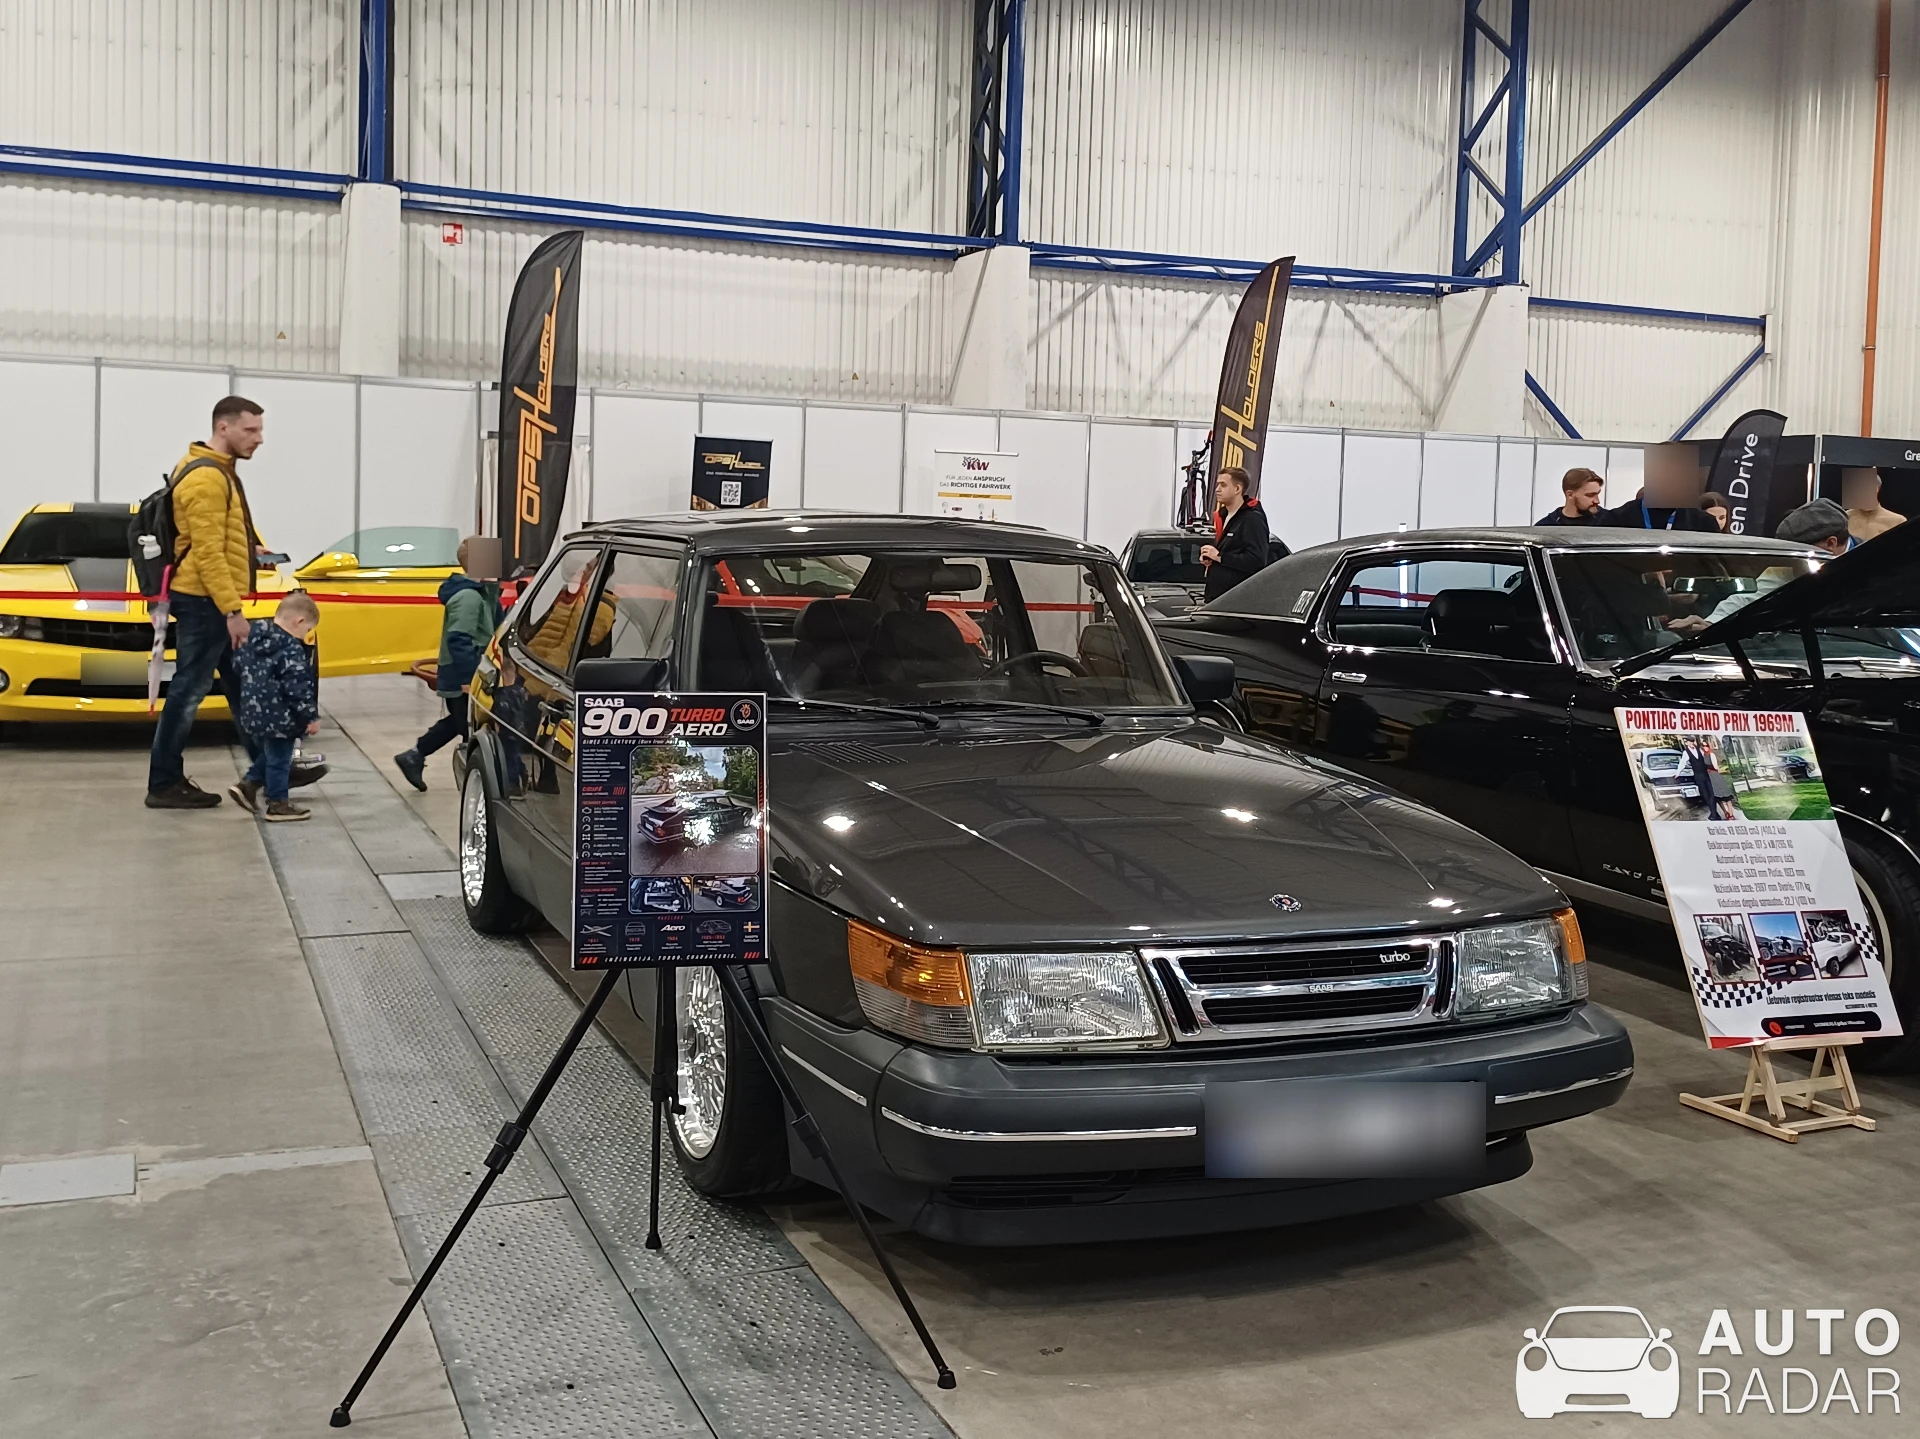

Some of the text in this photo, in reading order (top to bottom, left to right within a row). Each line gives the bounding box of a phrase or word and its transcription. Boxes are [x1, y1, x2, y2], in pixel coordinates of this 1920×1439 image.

[1221, 265, 1280, 468] SHOLDERS
[966, 461, 989, 471] KW
[950, 481, 978, 489] RICHTIGE
[979, 482, 1011, 490] FAHRWERK
[973, 475, 1005, 483] ANSPRUCH
[1728, 433, 1758, 534] en Drive
[584, 697, 625, 708] SAAB
[670, 708, 726, 722] TURBO
[1625, 710, 1677, 730] PONTIAC
[1680, 711, 1720, 731] GRAND
[1724, 713, 1750, 732] PRIX
[581, 707, 668, 737] 900
[668, 723, 728, 736] AERO
[660, 924, 686, 932] Aero
[1379, 950, 1411, 964] turbo
[1309, 984, 1334, 993] SAAB
